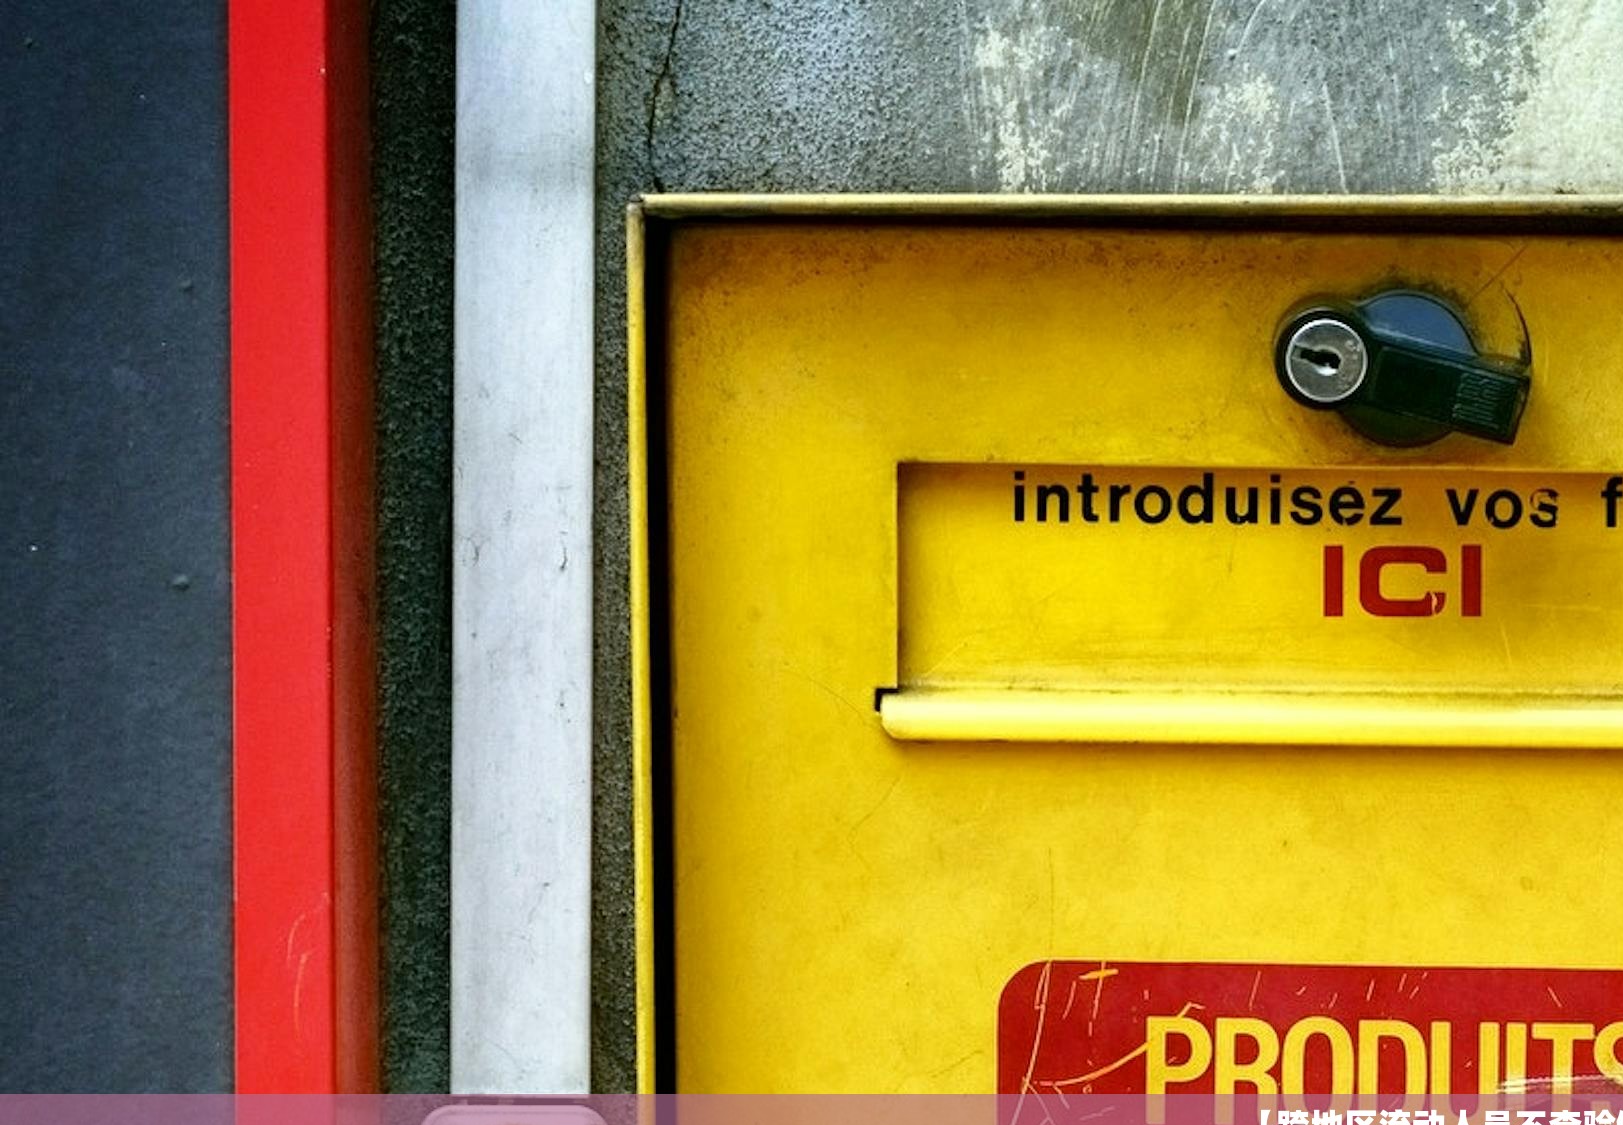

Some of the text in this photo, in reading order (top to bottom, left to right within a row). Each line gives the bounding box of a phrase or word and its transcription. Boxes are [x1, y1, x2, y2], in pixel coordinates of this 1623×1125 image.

[1013, 471, 1403, 526] introduisez
[1446, 488, 1560, 529] vos
[1323, 544, 1482, 617] ICI
